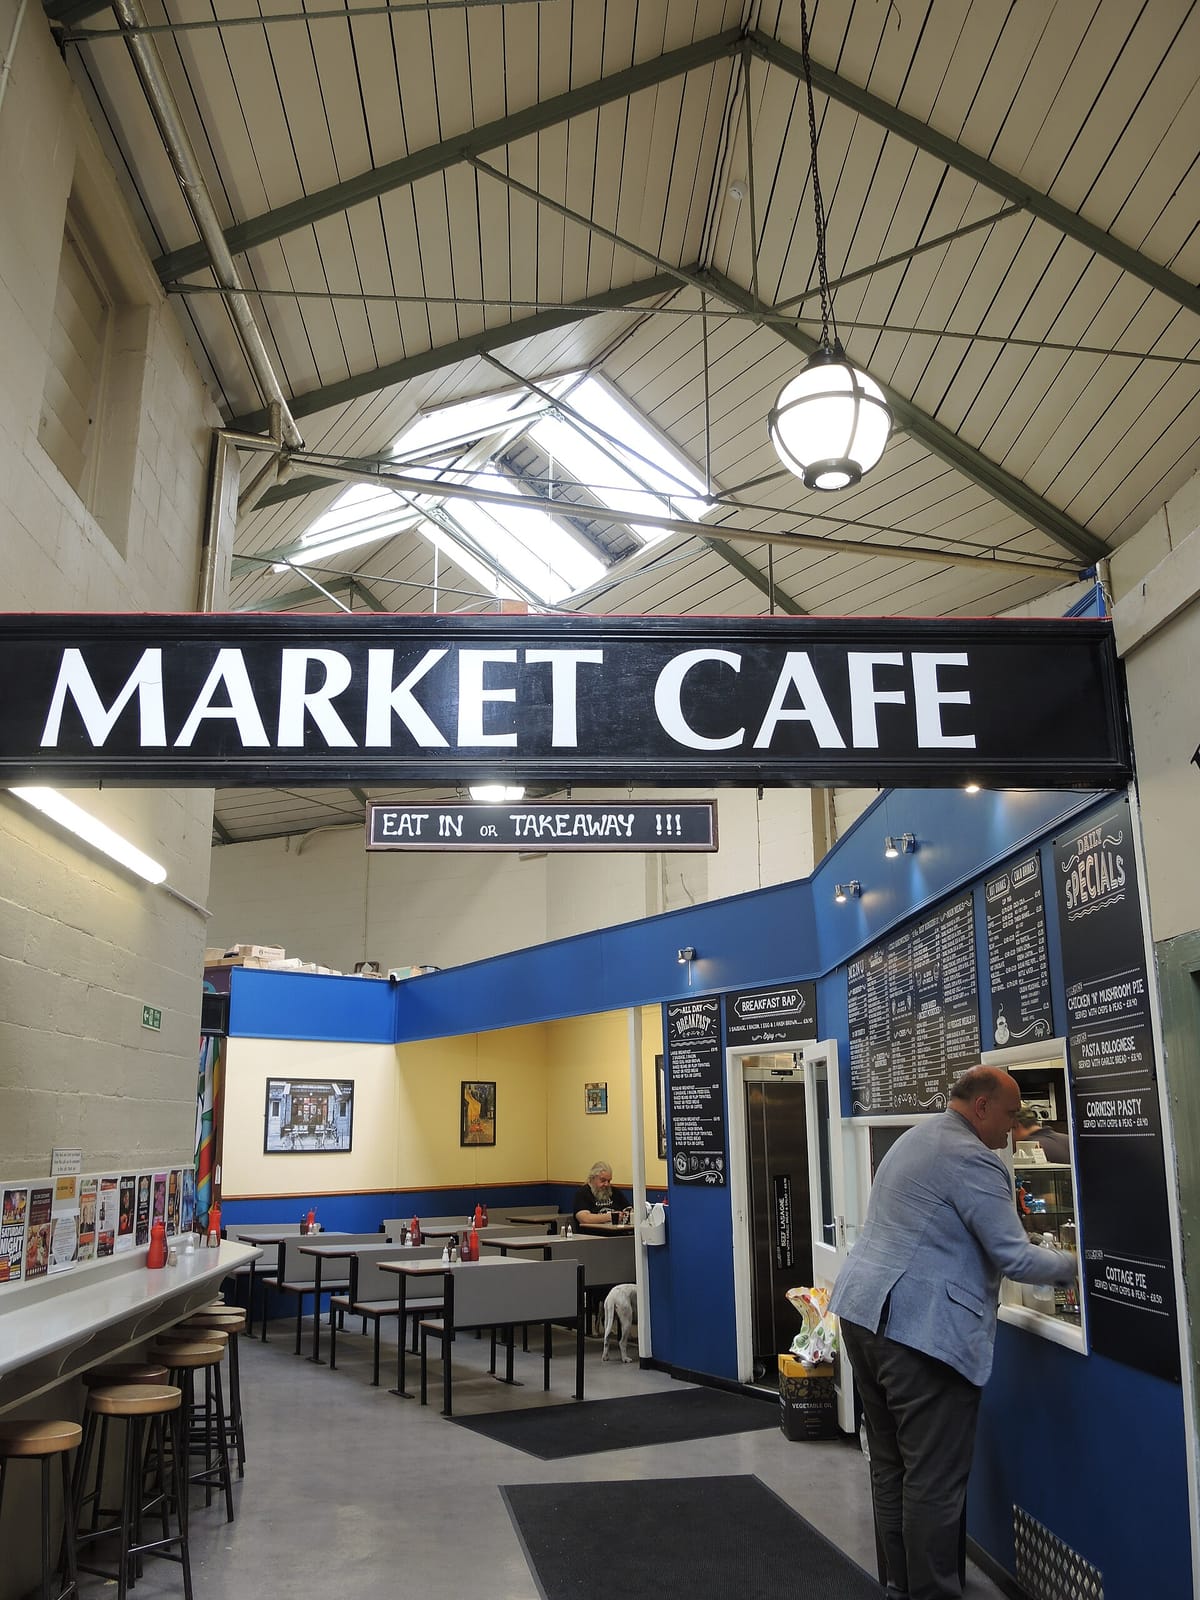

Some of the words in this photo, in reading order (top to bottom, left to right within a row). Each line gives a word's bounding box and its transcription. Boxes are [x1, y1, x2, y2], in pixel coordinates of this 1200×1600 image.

[40, 648, 603, 748] MARKET
[654, 648, 977, 750] CAFE
[382, 813, 429, 836] EAT
[438, 814, 463, 837] IN
[480, 824, 498, 838] OR
[509, 813, 635, 837] TAKEAWAY
[655, 813, 682, 836] !!!
[1077, 827, 1102, 855] DAILY
[1065, 851, 1126, 909] SPECIALS
[742, 996, 780, 1012] BREAKFAST
[781, 994, 797, 1007] BAP
[1068, 993, 1091, 1011] CHICKEN
[1099, 982, 1132, 1004] MUSHROOM
[1132, 978, 1145, 995] PIE
[675, 1013, 711, 1034] BREAKFAST
[1081, 1042, 1101, 1057] PASTA
[1101, 1035, 1136, 1055] BOLOGNESE
[1086, 1100, 1116, 1118] CORNISH
[1117, 1098, 1142, 1116] PASTY
[778, 1197, 786, 1230] LASAGNE
[0, 1236, 23, 1256] NIGHT
[1105, 1265, 1135, 1287] COTTAGE
[1135, 1272, 1147, 1289] PIE
